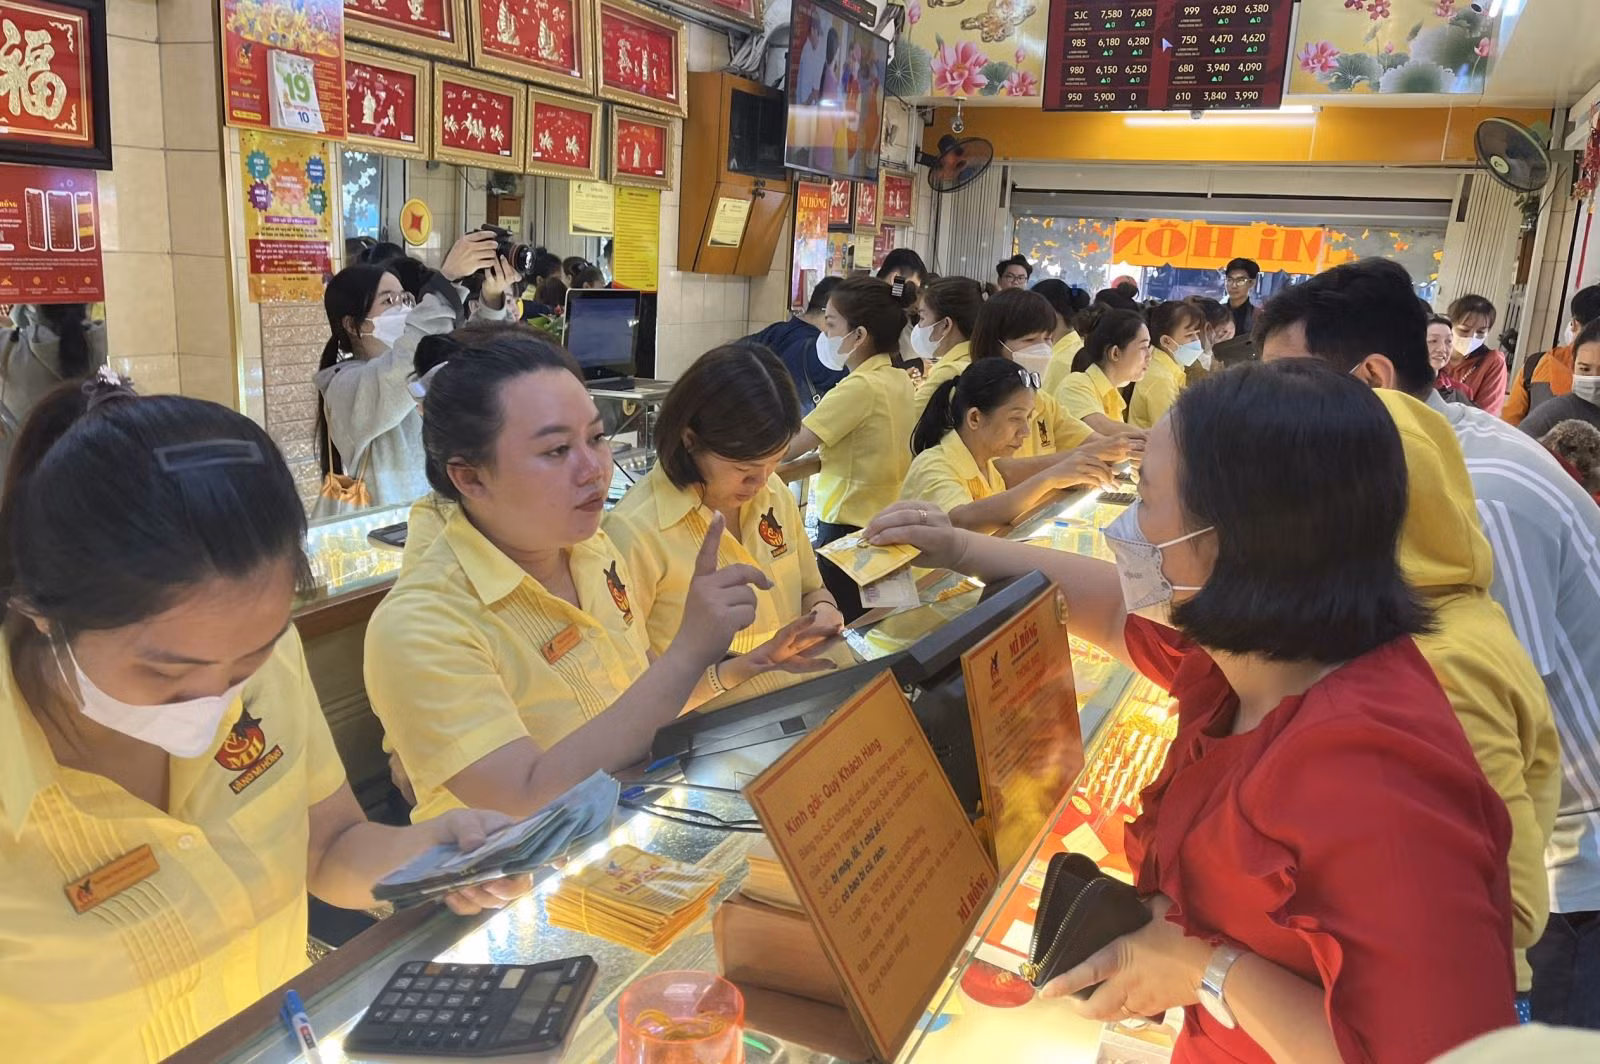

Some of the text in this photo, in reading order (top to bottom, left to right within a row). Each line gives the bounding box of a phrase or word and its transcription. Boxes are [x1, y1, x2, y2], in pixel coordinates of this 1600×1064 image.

[1074, 8, 1152, 20] SJC 7,580 7,680
[1212, 6, 1237, 15] 6,280
[1244, 4, 1269, 14] 6,380
[1072, 36, 1150, 47] 985 6,180 6,280
[1181, 33, 1265, 44] 750 4,470 4,620
[1096, 65, 1118, 74] 6,150
[1124, 65, 1147, 74] 6,250
[1178, 63, 1262, 72] 680 3,940 4,090
[283, 73, 310, 102] 19
[1067, 93, 1082, 101] 950
[1094, 92, 1115, 102] 5,900
[1203, 92, 1227, 101] 3,840
[1234, 91, 1258, 100] 3,990
[298, 112, 310, 123] 10
[784, 810, 808, 836] Kính
[837, 755, 863, 783] Khách
[860, 738, 882, 761] Hàng
